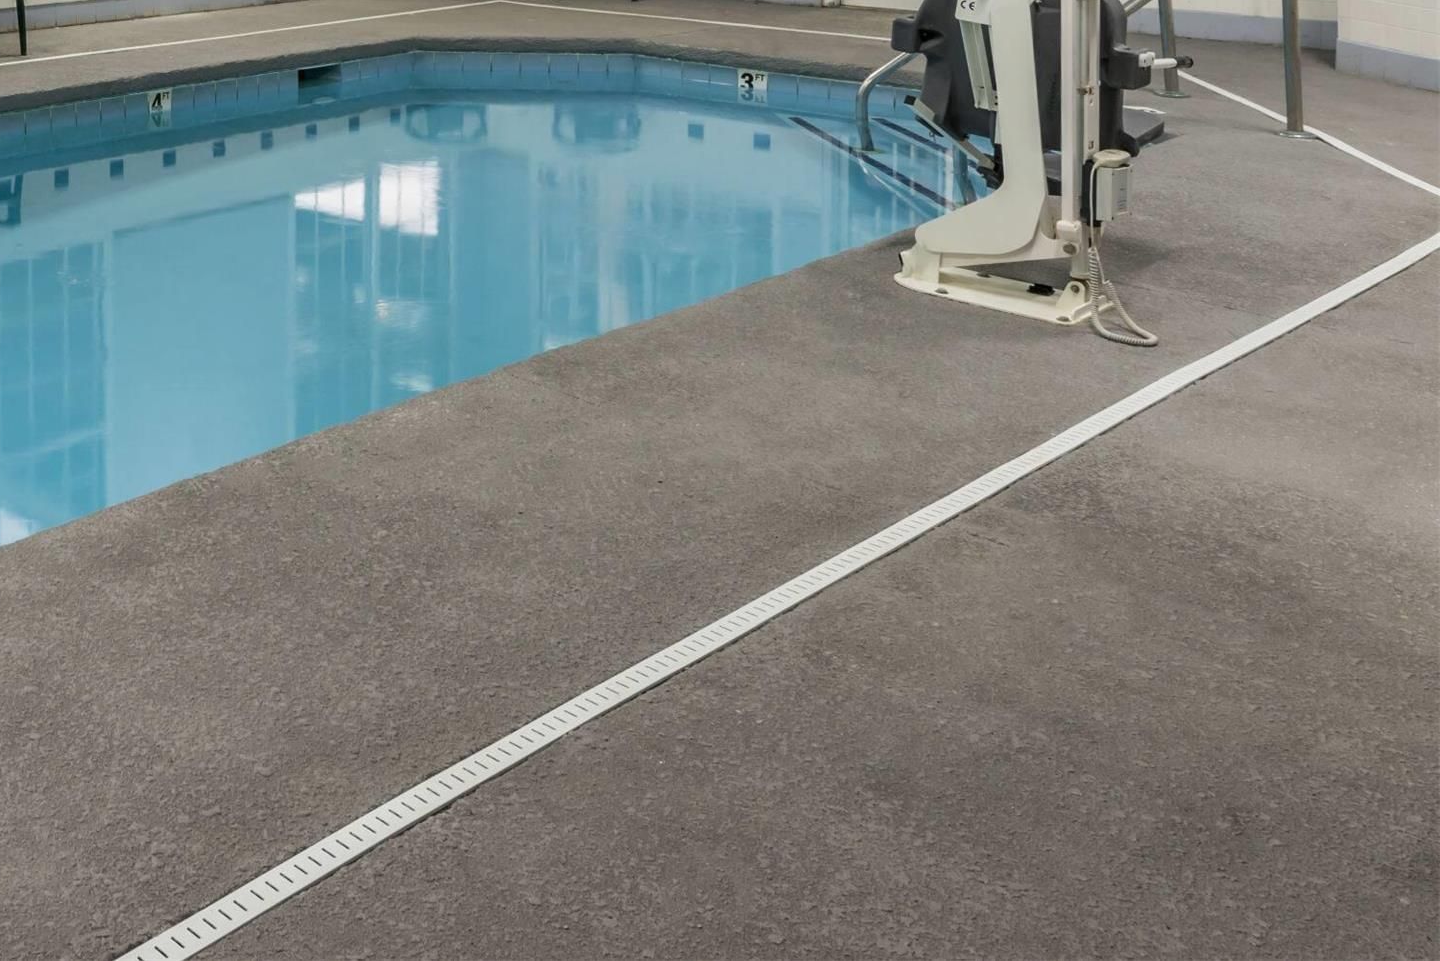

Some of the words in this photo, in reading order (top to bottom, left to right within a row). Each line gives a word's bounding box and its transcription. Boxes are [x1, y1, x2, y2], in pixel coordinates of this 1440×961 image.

[960, 0, 974, 10] CE
[741, 73, 754, 89] 3
[151, 93, 163, 110] 4
